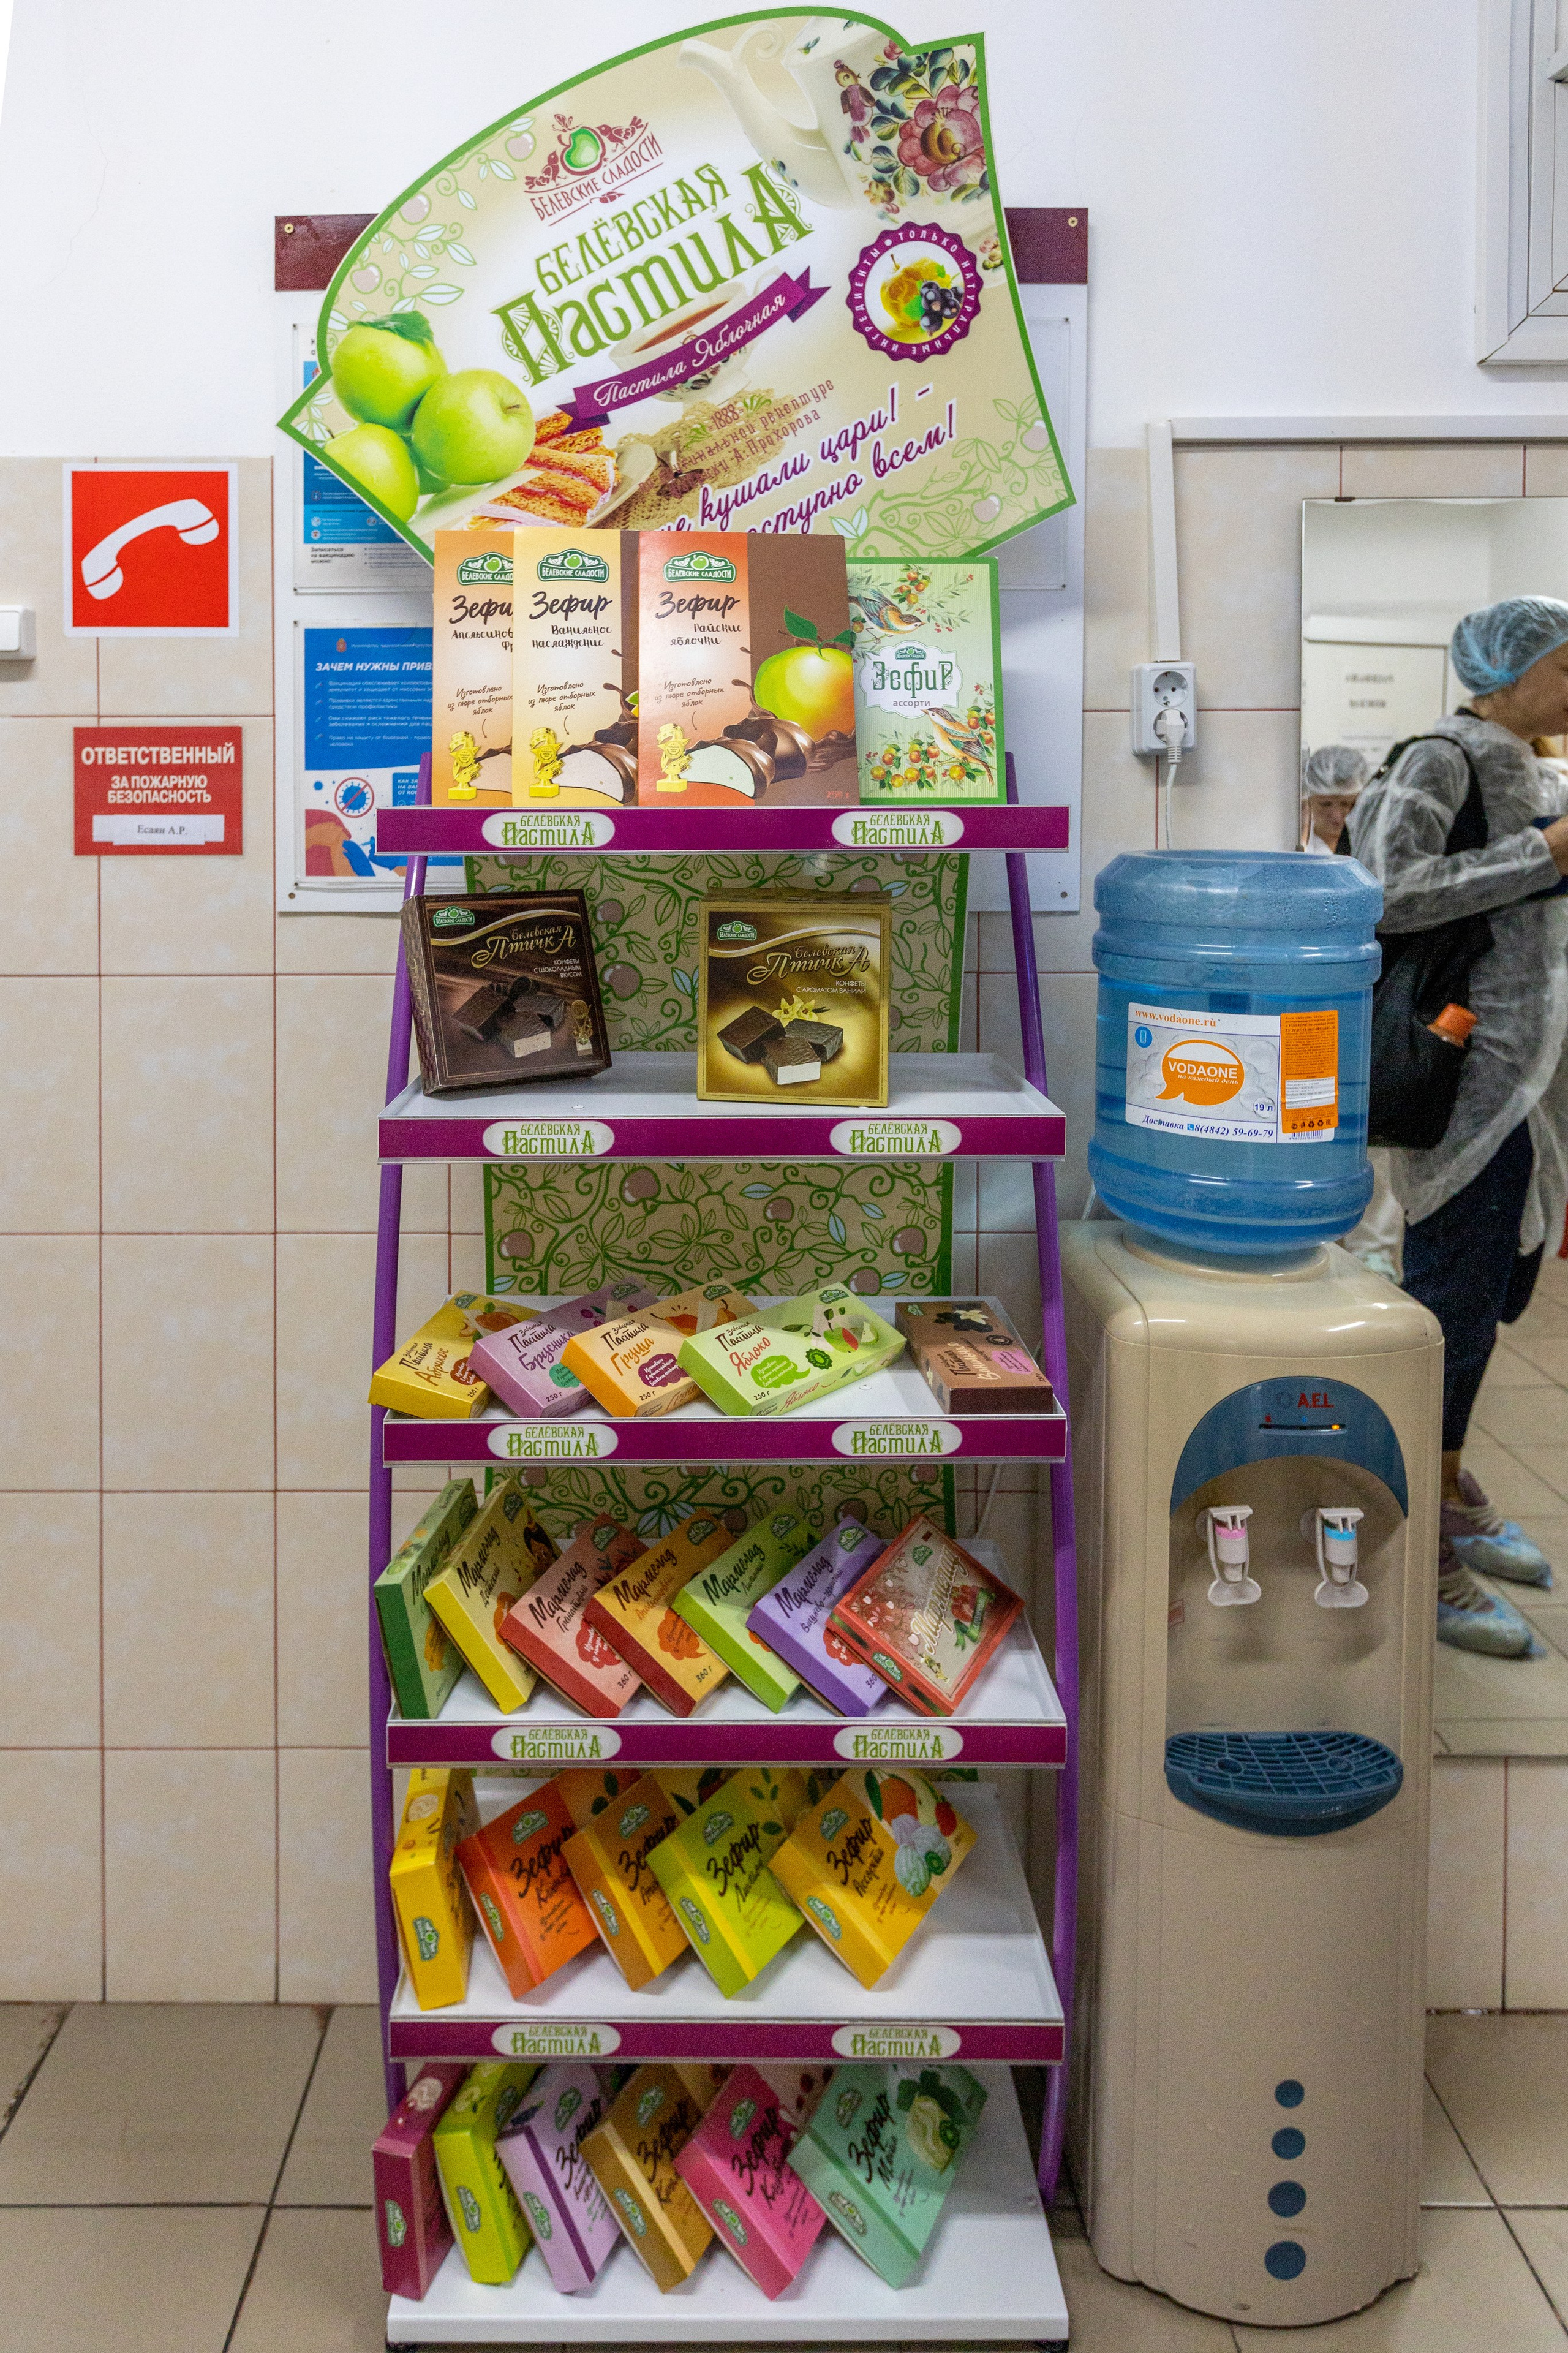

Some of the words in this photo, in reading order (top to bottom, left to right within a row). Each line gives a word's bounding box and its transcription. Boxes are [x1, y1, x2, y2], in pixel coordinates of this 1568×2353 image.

[530, 176, 602, 221] БЕЛЕВСКИЕ
[601, 131, 665, 188] СЛАДОСТИ
[534, 162, 732, 296] БЕЛЁВСКАЯ
[898, 230, 959, 253] ТОЛЬКО
[853, 247, 899, 352] ИНГРЕДИЕНТЫ
[911, 260, 976, 355] НАТУРАЛЬНЫЕ
[593, 360, 687, 407] Пастила
[691, 292, 786, 366] Яблочная
[759, 379, 835, 428] рецептуре
[731, 409, 821, 464] А.Прохорова
[699, 452, 810, 532] кушали
[820, 385, 899, 464] цари!
[746, 472, 862, 534] ступно
[872, 402, 957, 478] всем!
[462, 569, 494, 581] БЕЛЕВСКИЕ
[541, 567, 574, 578] БЕЛЕВСКИЕ
[575, 567, 605, 578] СЛАДОСТИ
[667, 568, 700, 578] БЕЛЕВСКИЕ
[701, 568, 733, 580] СЛАДОСТИ
[448, 594, 514, 625] Зефи
[529, 590, 612, 621] Зефир
[655, 590, 741, 619] Зефир
[551, 624, 612, 635] Ванильное
[693, 622, 744, 633] Райские
[532, 637, 605, 649] наслаждение
[669, 636, 722, 646] яблочки
[315, 662, 354, 672] ЗАЧЕМ
[355, 662, 401, 672] НУЖНЫ
[401, 661, 433, 671] ПРИВ
[456, 684, 502, 700] Изготовлено
[537, 680, 584, 696] Изготовлено
[663, 676, 712, 692] Изготовлено
[447, 703, 455, 712] из
[458, 699, 475, 709] пюре
[477, 694, 514, 705] отборных
[538, 693, 557, 704] пюре
[557, 689, 596, 703] отборных
[654, 693, 663, 704] из
[665, 690, 684, 700] пюре
[686, 685, 725, 699] отборных
[680, 697, 704, 708] яблок
[472, 706, 494, 716] яблок
[554, 701, 576, 712] яблок
[892, 700, 931, 709] ассорти
[81, 742, 235, 766] ОТВЕТСТВЕННЫЙ
[111, 774, 129, 790] ЗА
[130, 773, 208, 790] ПОЖАРНУЮ
[107, 788, 212, 804] БЕЗОПАСНОСТЬ
[521, 814, 581, 826] БЕЛЁВСКАЯ
[870, 813, 930, 826] БЕЛЁВСКАЯ
[137, 823, 164, 836] Есаян
[167, 823, 189, 836] А.Р.
[511, 924, 562, 940] Белевская
[793, 945, 856, 958] Белевская
[539, 965, 582, 973] ШОКОЛАДНЫМ
[1134, 1009, 1217, 1028] www.vodaone.ru
[1168, 1060, 1238, 1079] VODAONE
[1188, 1075, 1220, 1084] каждый
[1254, 1103, 1264, 1111] 19
[521, 1122, 581, 1136] БЕЛЁВСКАЯ
[868, 1122, 928, 1135] БЕЛЁВСКАЯ
[1142, 1114, 1185, 1130] Доставка
[1194, 1124, 1230, 1137] 8(4842)
[1232, 1128, 1274, 1138] 59-69-79
[507, 1323, 557, 1353] Пастила
[600, 1322, 649, 1351] Пастила
[715, 1323, 764, 1352] Пастила
[399, 1342, 434, 1370] Пастила
[518, 1330, 576, 1372] Брусника
[610, 1337, 655, 1377] Груша
[729, 1336, 771, 1377] Яблоко
[414, 1348, 450, 1386] Абрикос
[546, 1393, 558, 1402] 250
[639, 1392, 651, 1401] 250
[753, 1392, 766, 1401] 250
[525, 1426, 585, 1439] БЕЛЁВСКАЯ
[869, 1423, 929, 1436] БЕЛЁВСКАЯ
[456, 1526, 502, 1598] Мармелад
[611, 1548, 678, 1612] Мармелад
[701, 1543, 766, 1607] Мармелад
[774, 1555, 834, 1619] Мармелад
[527, 1562, 588, 1630] Мармелад
[910, 1544, 968, 1656] Мармелад
[617, 1673, 630, 1690] 360
[695, 1667, 709, 1684] 360
[865, 1673, 878, 1689] 360
[529, 1728, 588, 1740] БЕЛЁВСКАЯ
[871, 1728, 930, 1740] БЕЛЁВСКАЯ
[707, 1822, 763, 1898] Зефир
[826, 1817, 878, 1886] Зефир
[510, 1826, 576, 1898] Зефир
[847, 2091, 898, 2185] Зефир
[731, 2107, 782, 2197] Зефир
